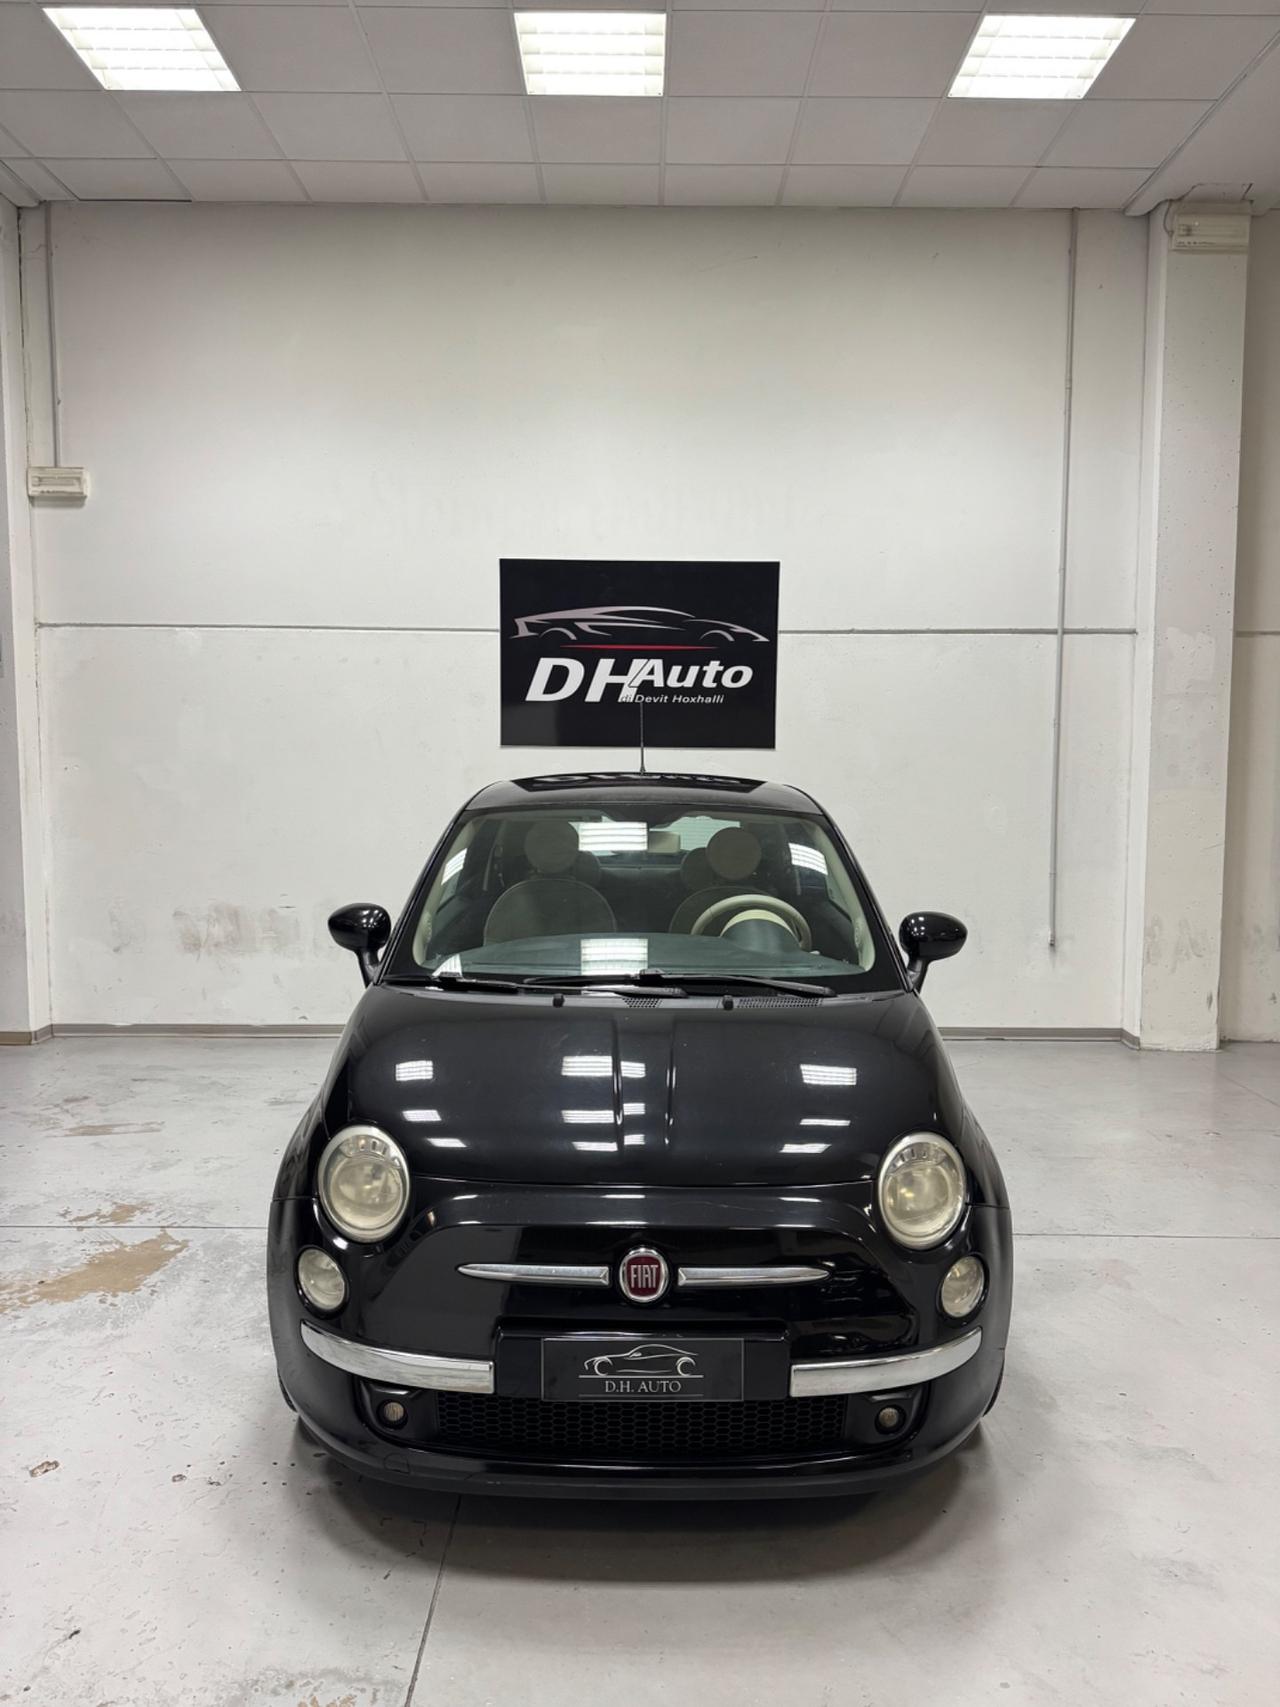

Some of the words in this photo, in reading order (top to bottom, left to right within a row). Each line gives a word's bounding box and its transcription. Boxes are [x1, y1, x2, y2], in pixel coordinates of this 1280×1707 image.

[634, 693, 669, 704] Devit
[672, 693, 725, 705] Hoxhalli
[630, 1264, 659, 1289] FIAT
[605, 1380, 635, 1393] D.H.
[639, 1380, 682, 1393] AUTO
